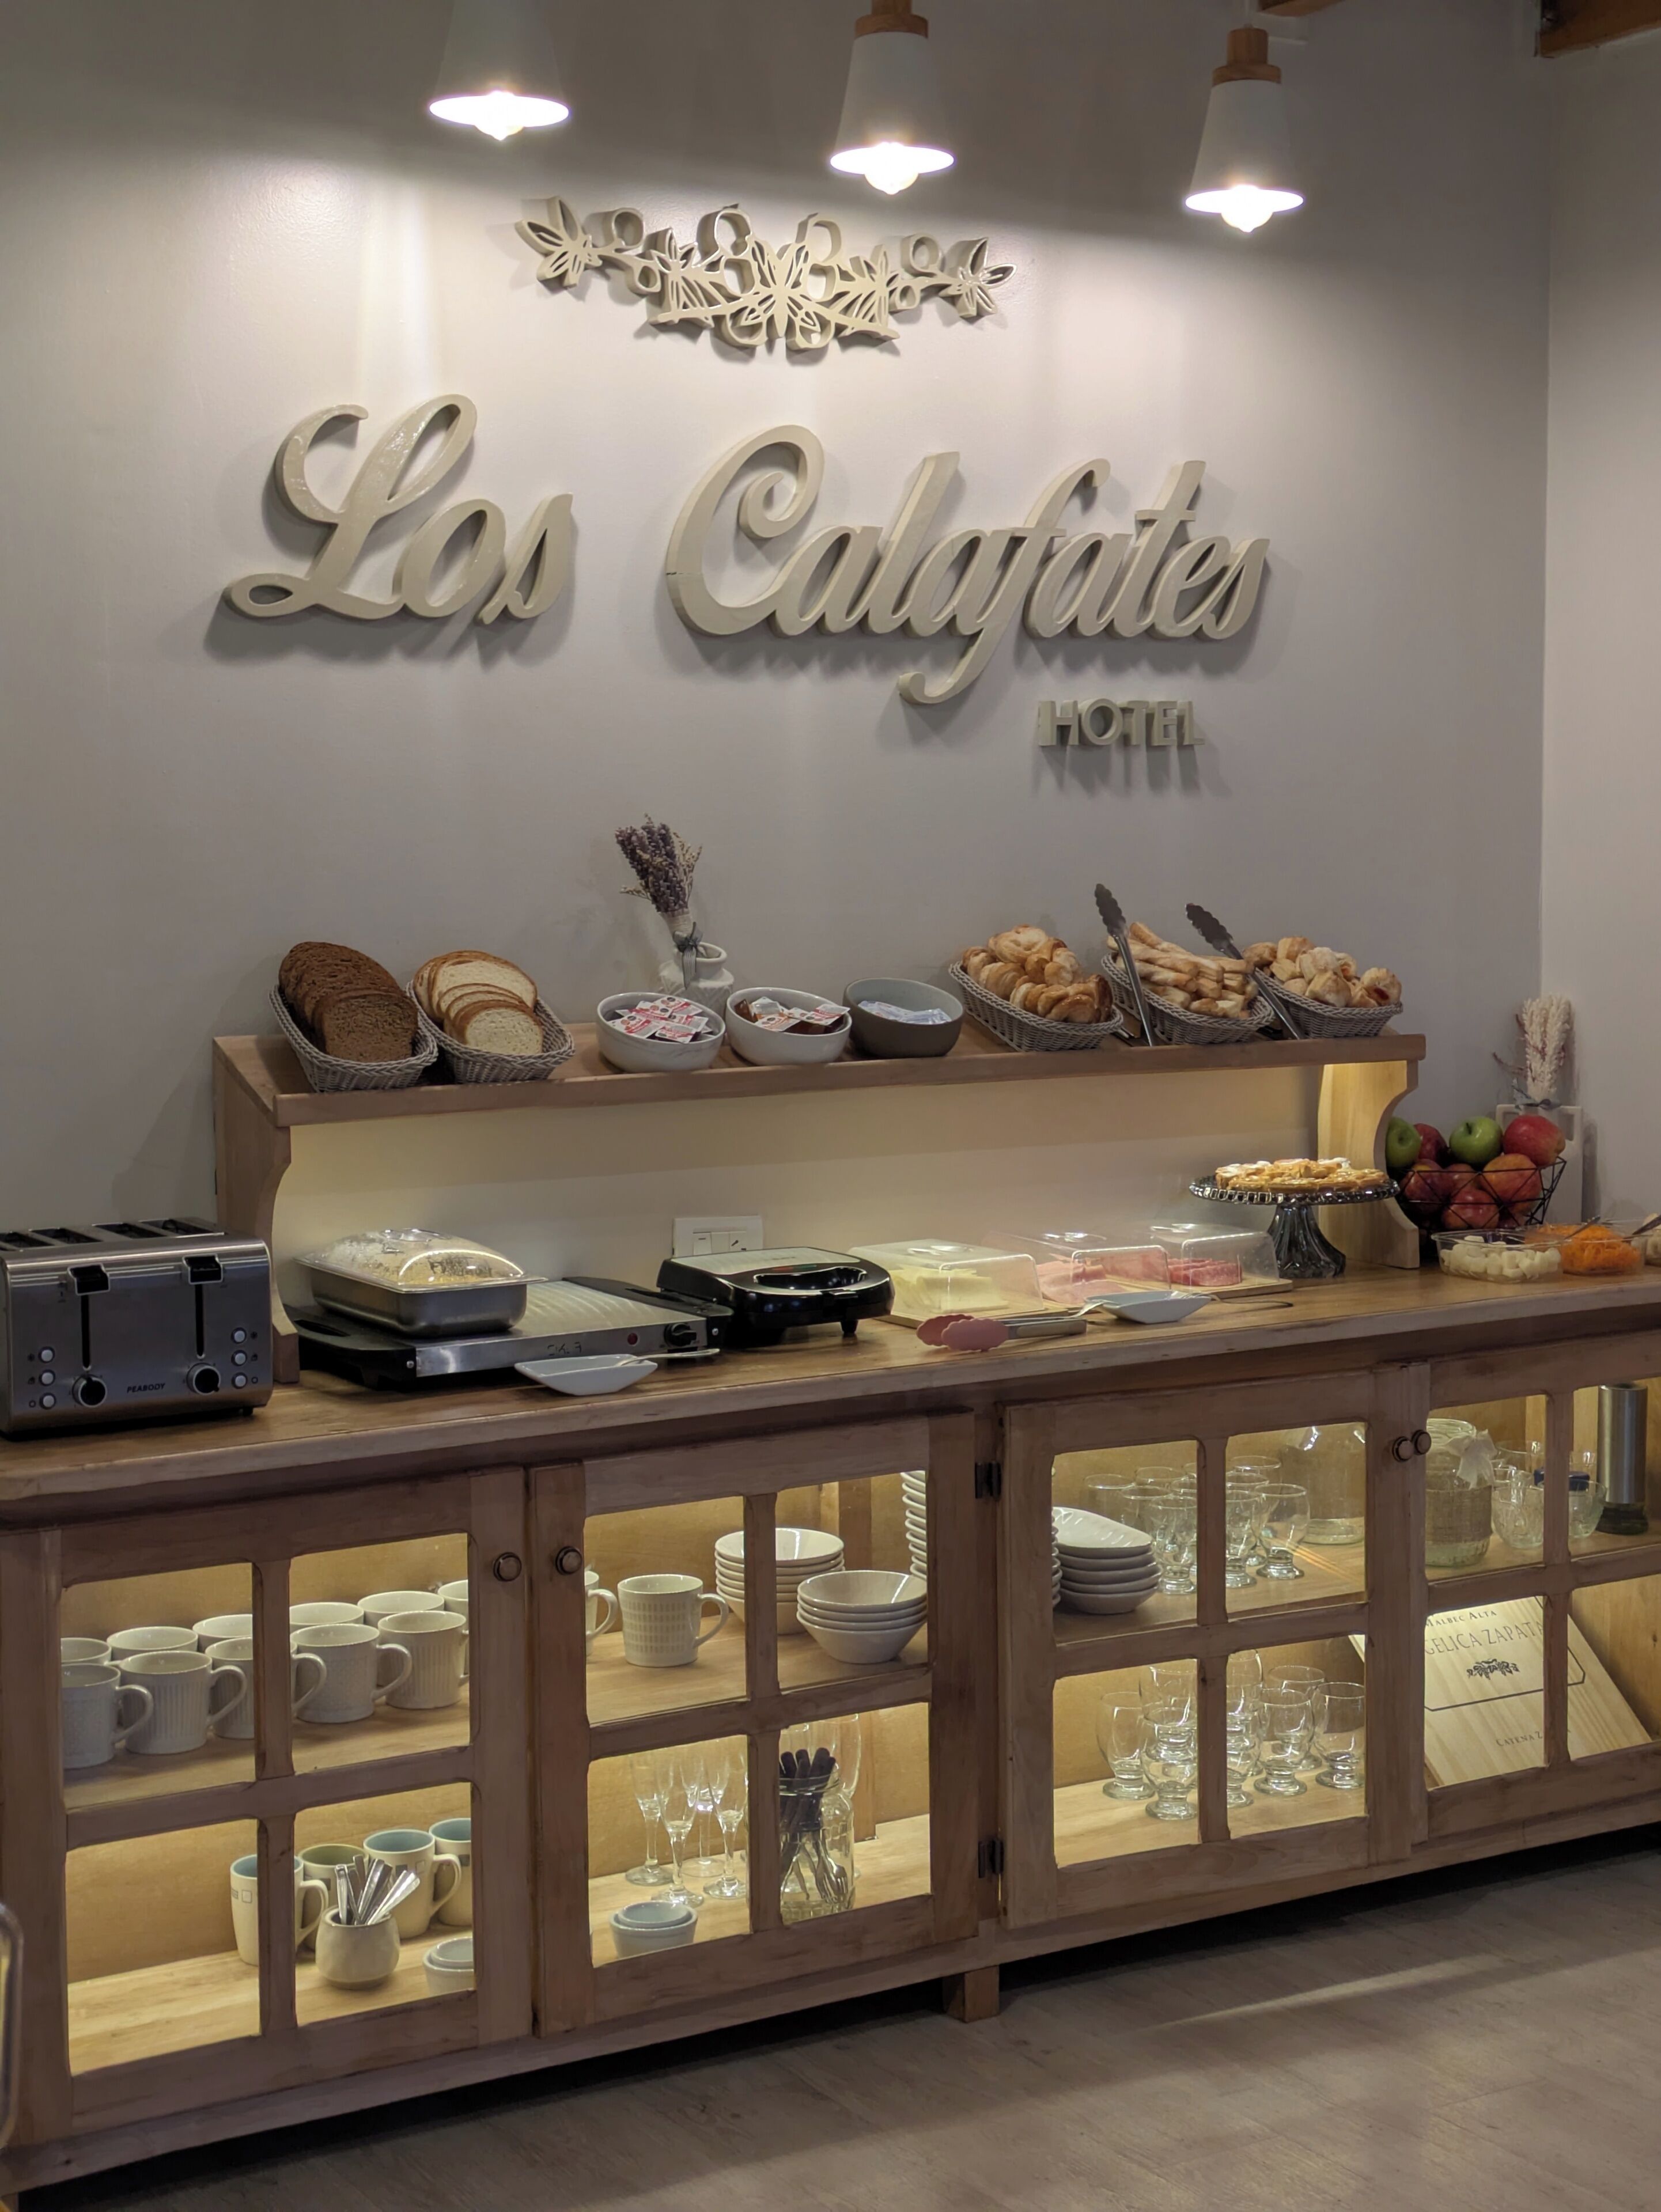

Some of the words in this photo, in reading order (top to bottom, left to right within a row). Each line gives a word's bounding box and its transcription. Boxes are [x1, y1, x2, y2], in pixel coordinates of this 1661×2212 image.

[222, 394, 573, 624] Los
[665, 424, 1269, 704] Calafates
[1038, 698, 1205, 746] HOTEL
[127, 1382, 165, 1393] PEABODY
[1426, 1615, 1465, 1627] MALBEC
[1469, 1611, 1497, 1620] ALTA
[1425, 1633, 1482, 1655] GELICA
[1482, 1622, 1543, 1644] ZAPATA
[1496, 1734, 1535, 1747] CATENA
